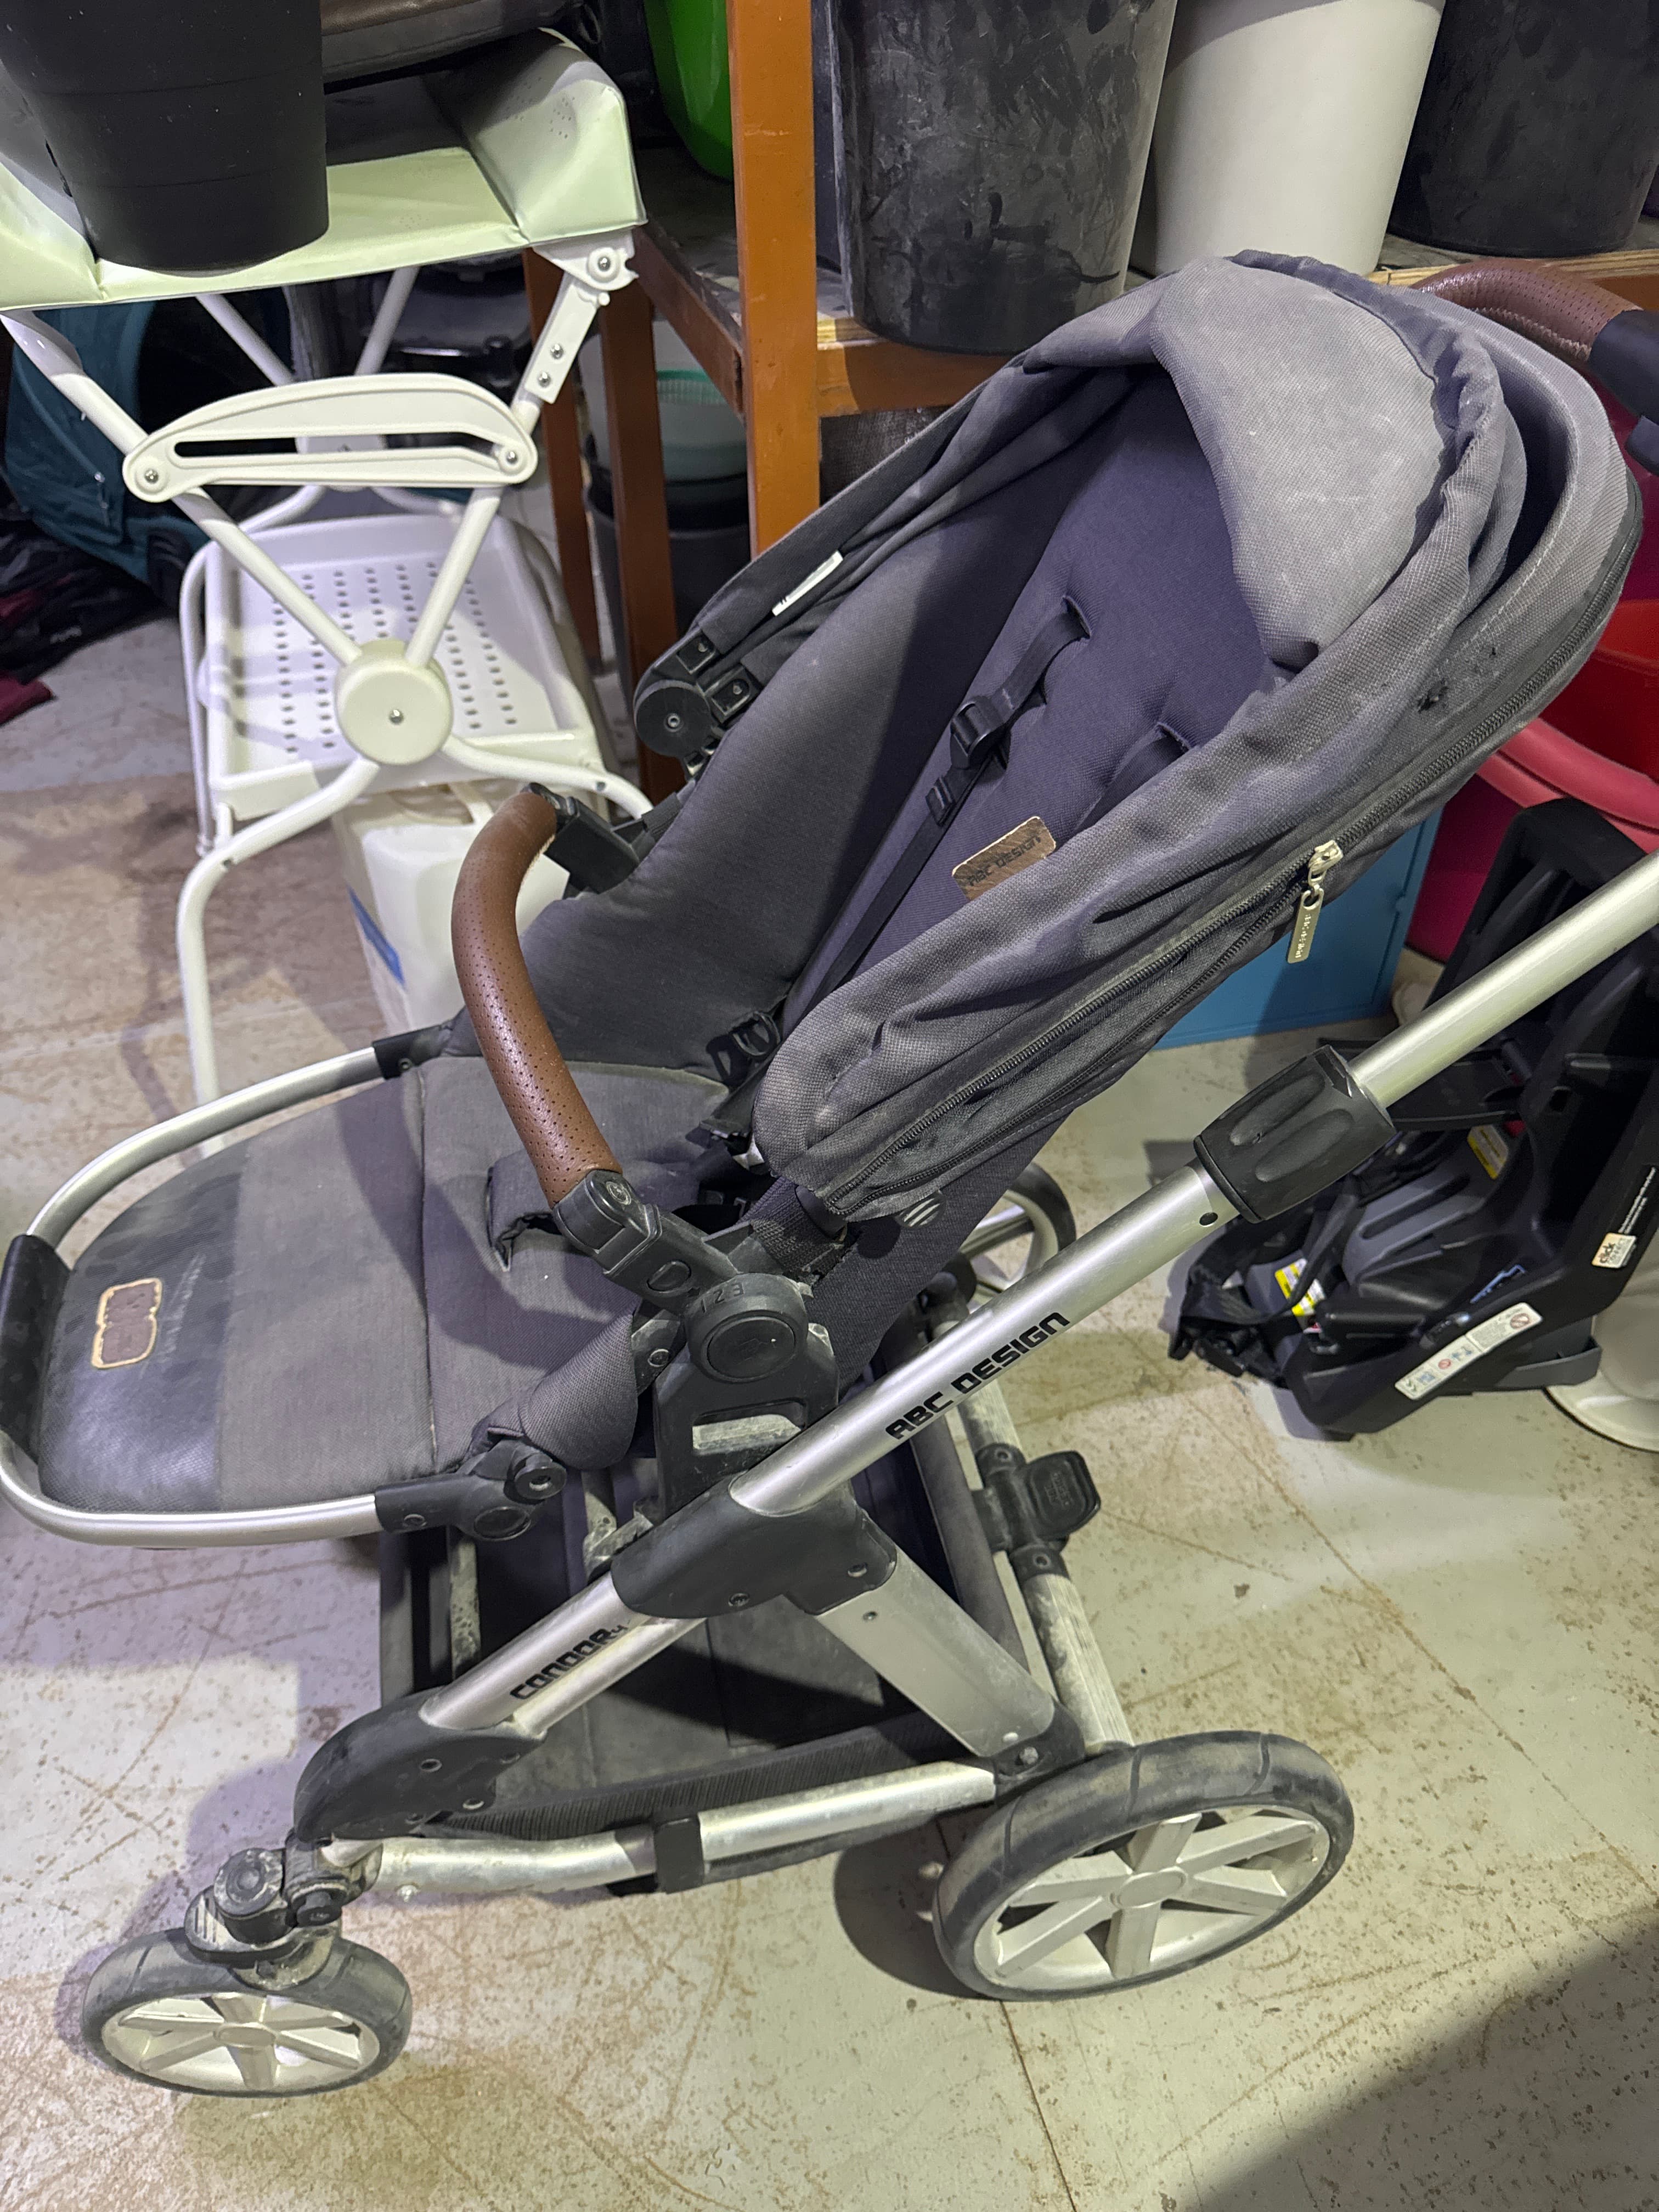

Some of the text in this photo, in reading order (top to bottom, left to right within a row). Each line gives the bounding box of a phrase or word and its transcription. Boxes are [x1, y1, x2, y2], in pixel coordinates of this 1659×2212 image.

[966, 865, 993, 887] ABC
[713, 1289, 725, 1304] 2
[731, 1282, 744, 1297] 3
[885, 1312, 1070, 1440] ABC DESIGN
[510, 1628, 615, 1699] CONDOR
